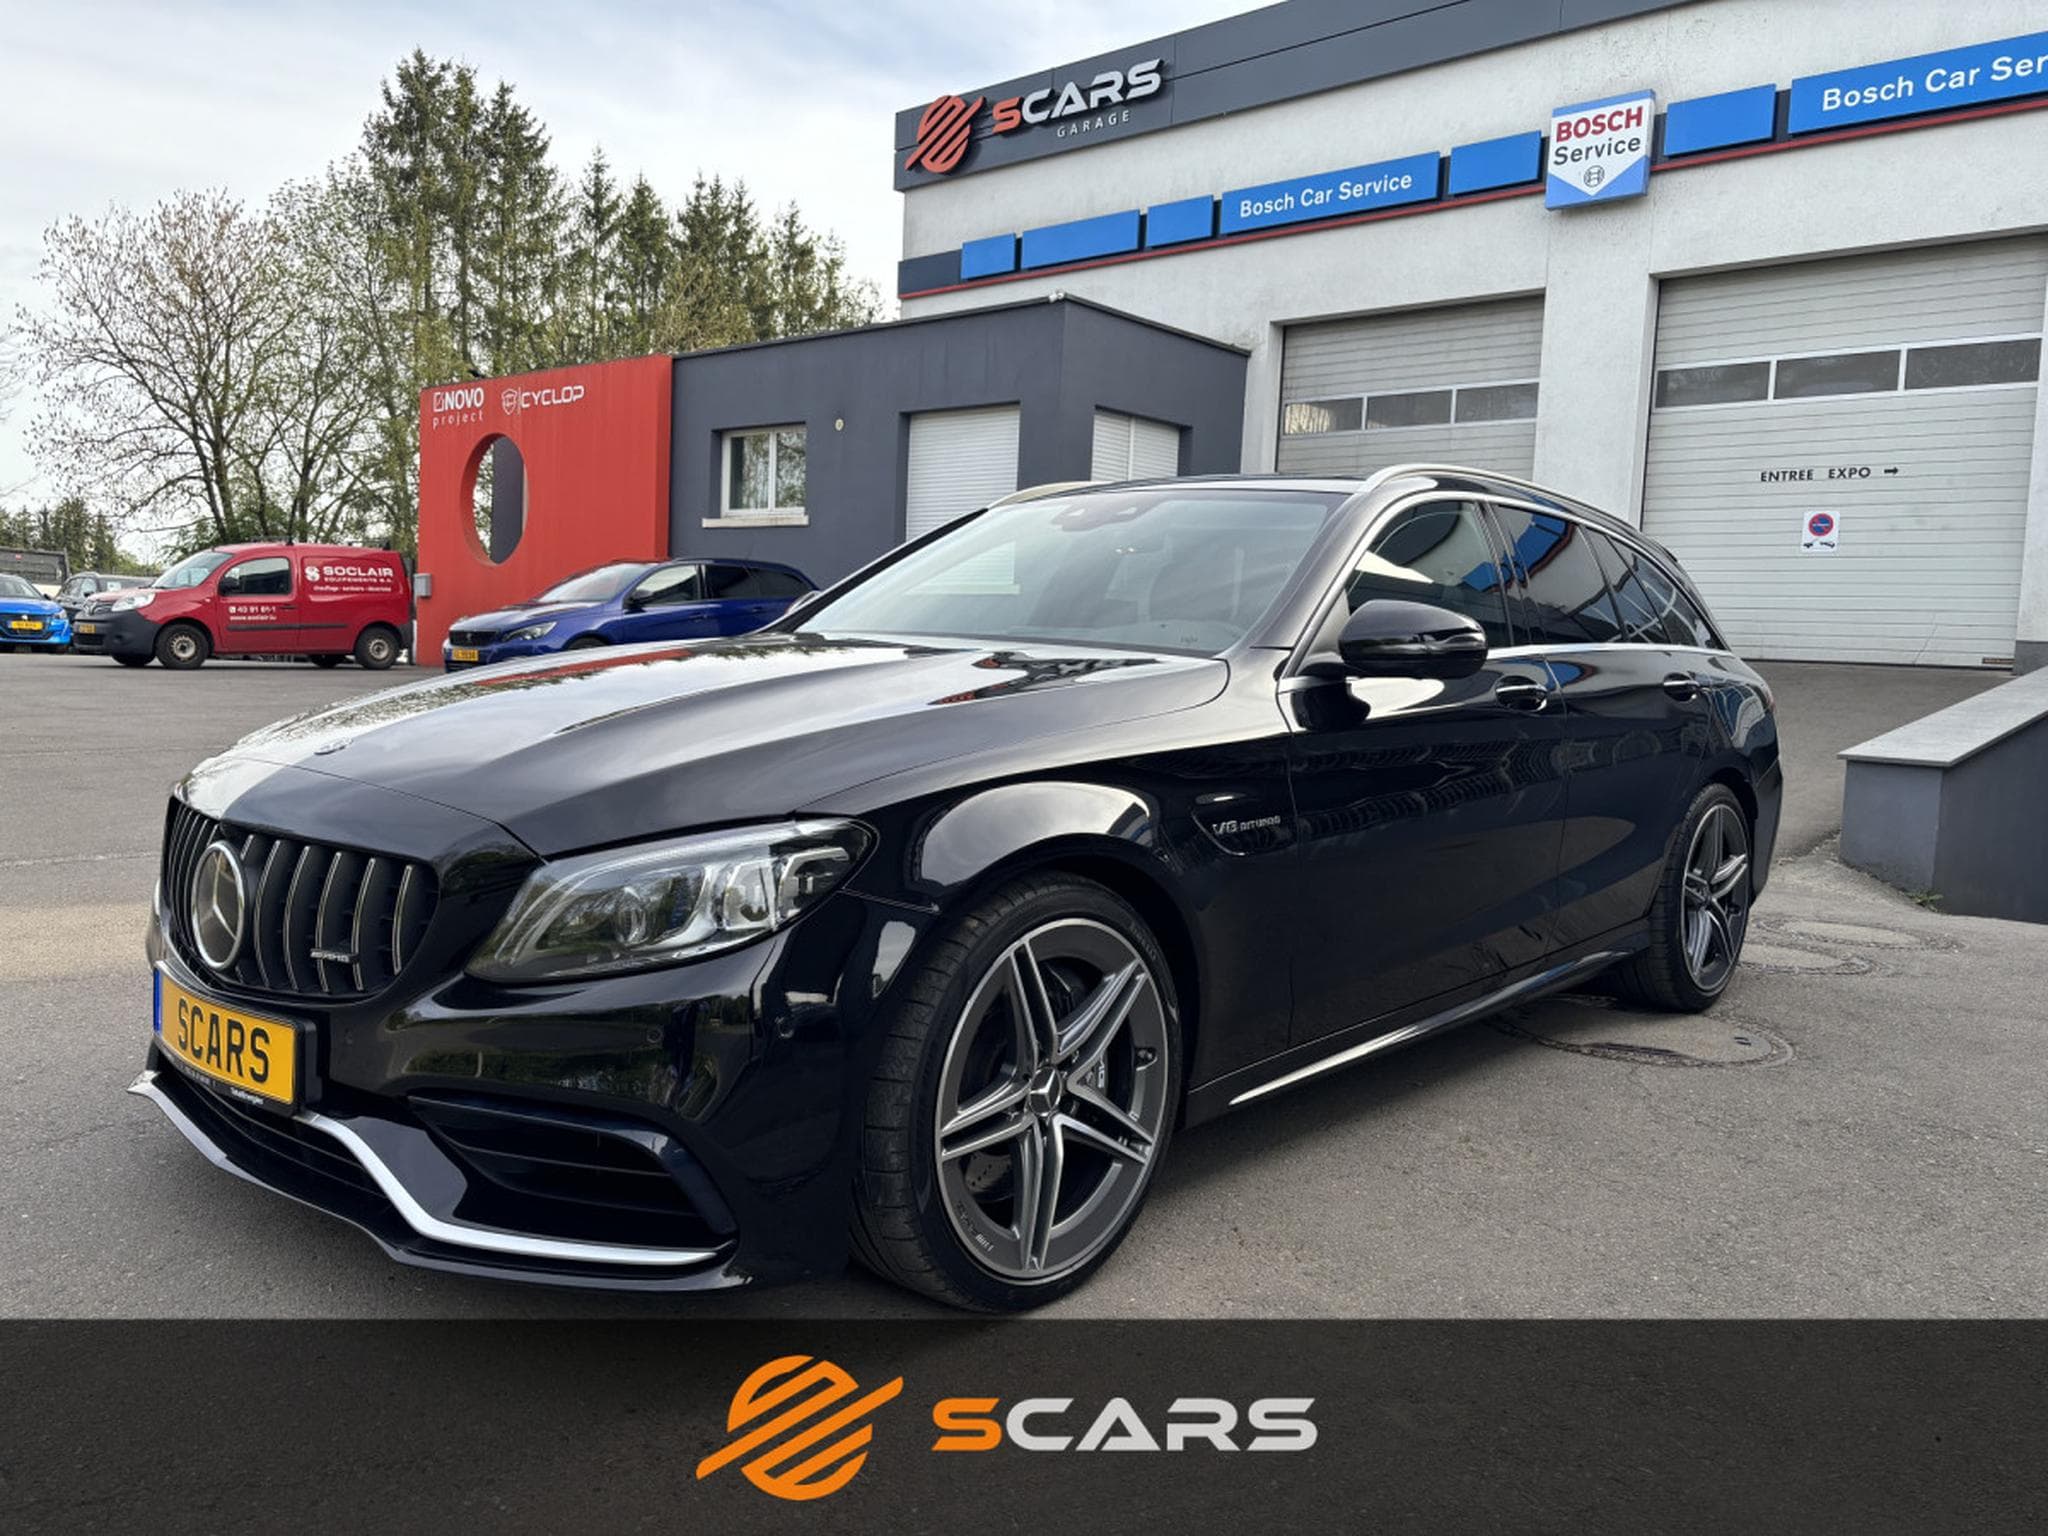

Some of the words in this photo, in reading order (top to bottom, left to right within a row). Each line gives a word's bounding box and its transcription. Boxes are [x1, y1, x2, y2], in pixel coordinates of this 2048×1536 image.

[992, 58, 1163, 134] SCARS
[1822, 77, 1914, 111] Bosch
[1925, 67, 1980, 91] Car
[1057, 110, 1130, 137] GARAGE
[1556, 105, 1643, 142] BOSCH
[1553, 137, 1641, 166] Service
[1240, 192, 1295, 218] Bosch
[1301, 187, 1333, 207] Car
[1338, 174, 1413, 200] Service
[521, 385, 585, 409] CYCLOP
[433, 410, 484, 429] project
[1760, 468, 1815, 482] ENTREE
[1828, 466, 1872, 480] EXPO
[323, 566, 394, 577] SOCLAIR
[178, 998, 270, 1083] SCARS
